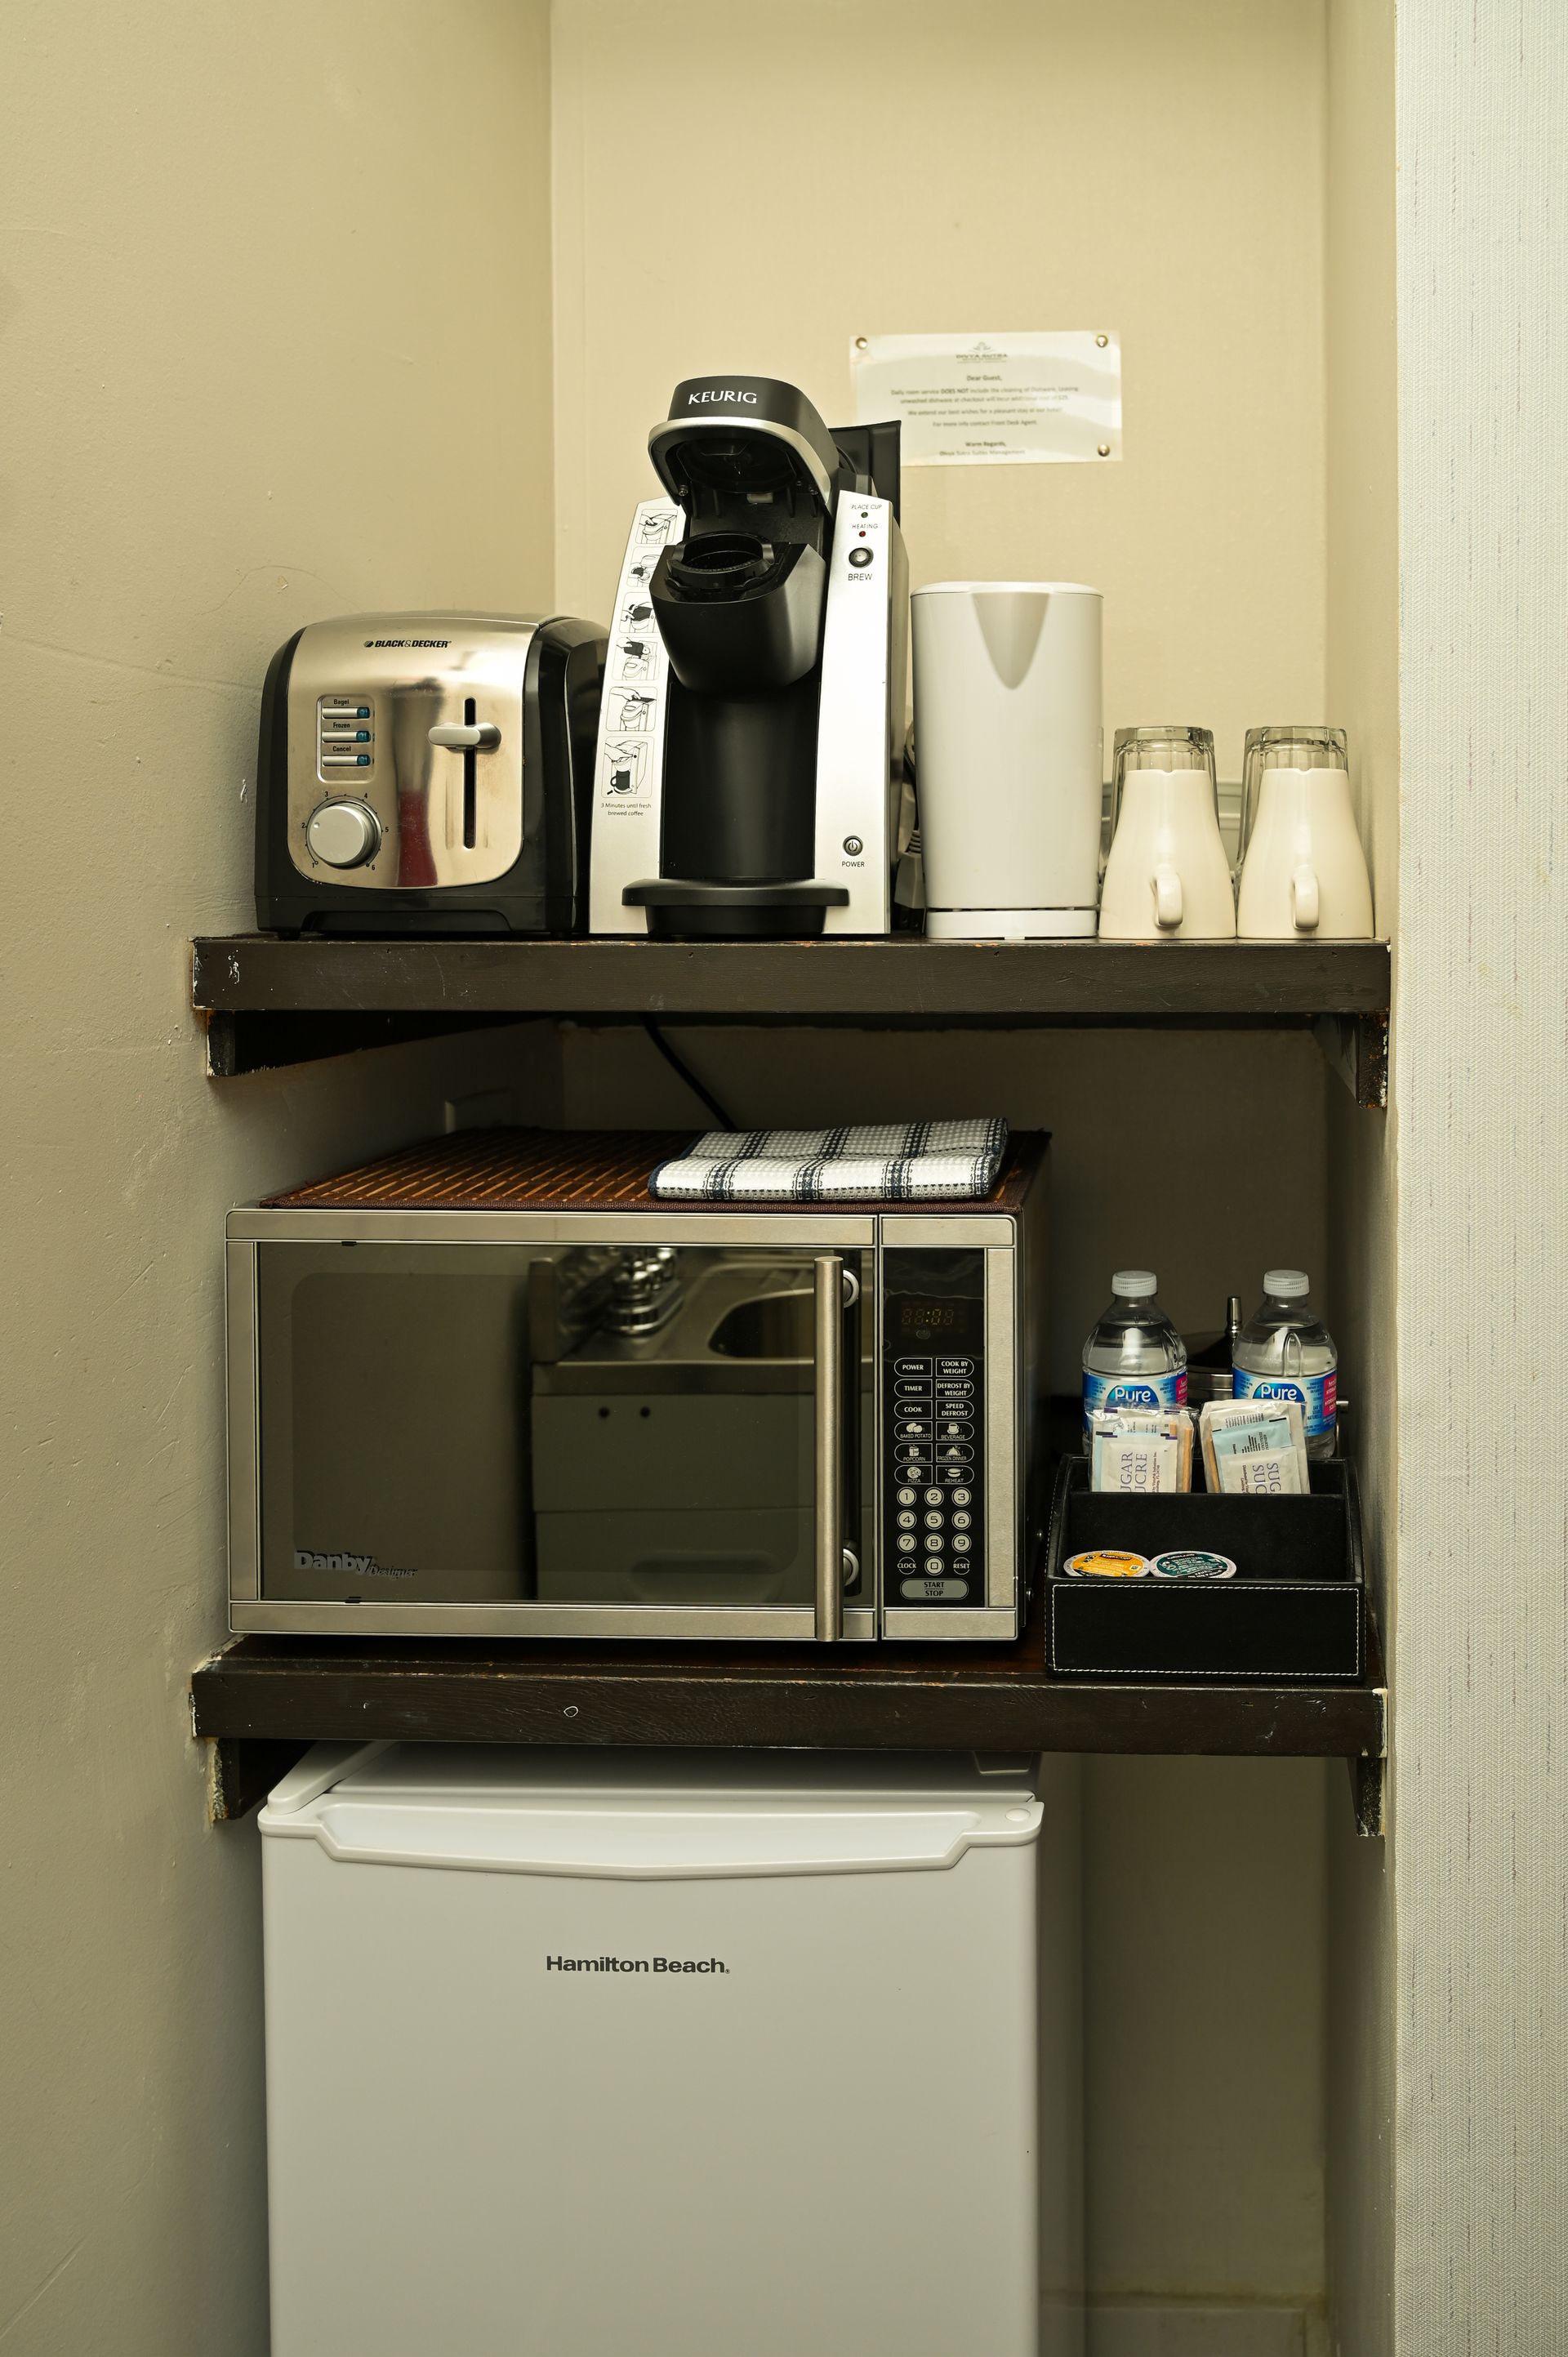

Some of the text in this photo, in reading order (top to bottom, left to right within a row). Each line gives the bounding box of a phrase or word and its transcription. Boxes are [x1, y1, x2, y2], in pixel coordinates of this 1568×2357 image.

[688, 390, 758, 405] KEURIG
[848, 573, 873, 581] BREW
[374, 639, 450, 648] BLACK&DECKER
[333, 698, 350, 706] Bagel
[1115, 1386, 1152, 1402] Pure
[1261, 1384, 1297, 1401] Pure
[1120, 1451, 1134, 1493] UGAR
[1134, 1452, 1148, 1493] UCRE
[902, 1539, 911, 1547] 7
[930, 1539, 938, 1547] 8
[957, 1539, 966, 1547] 9
[294, 1551, 418, 1580] Danby Designer
[930, 1562, 938, 1570] 0
[546, 1956, 649, 1972] Hamilton
